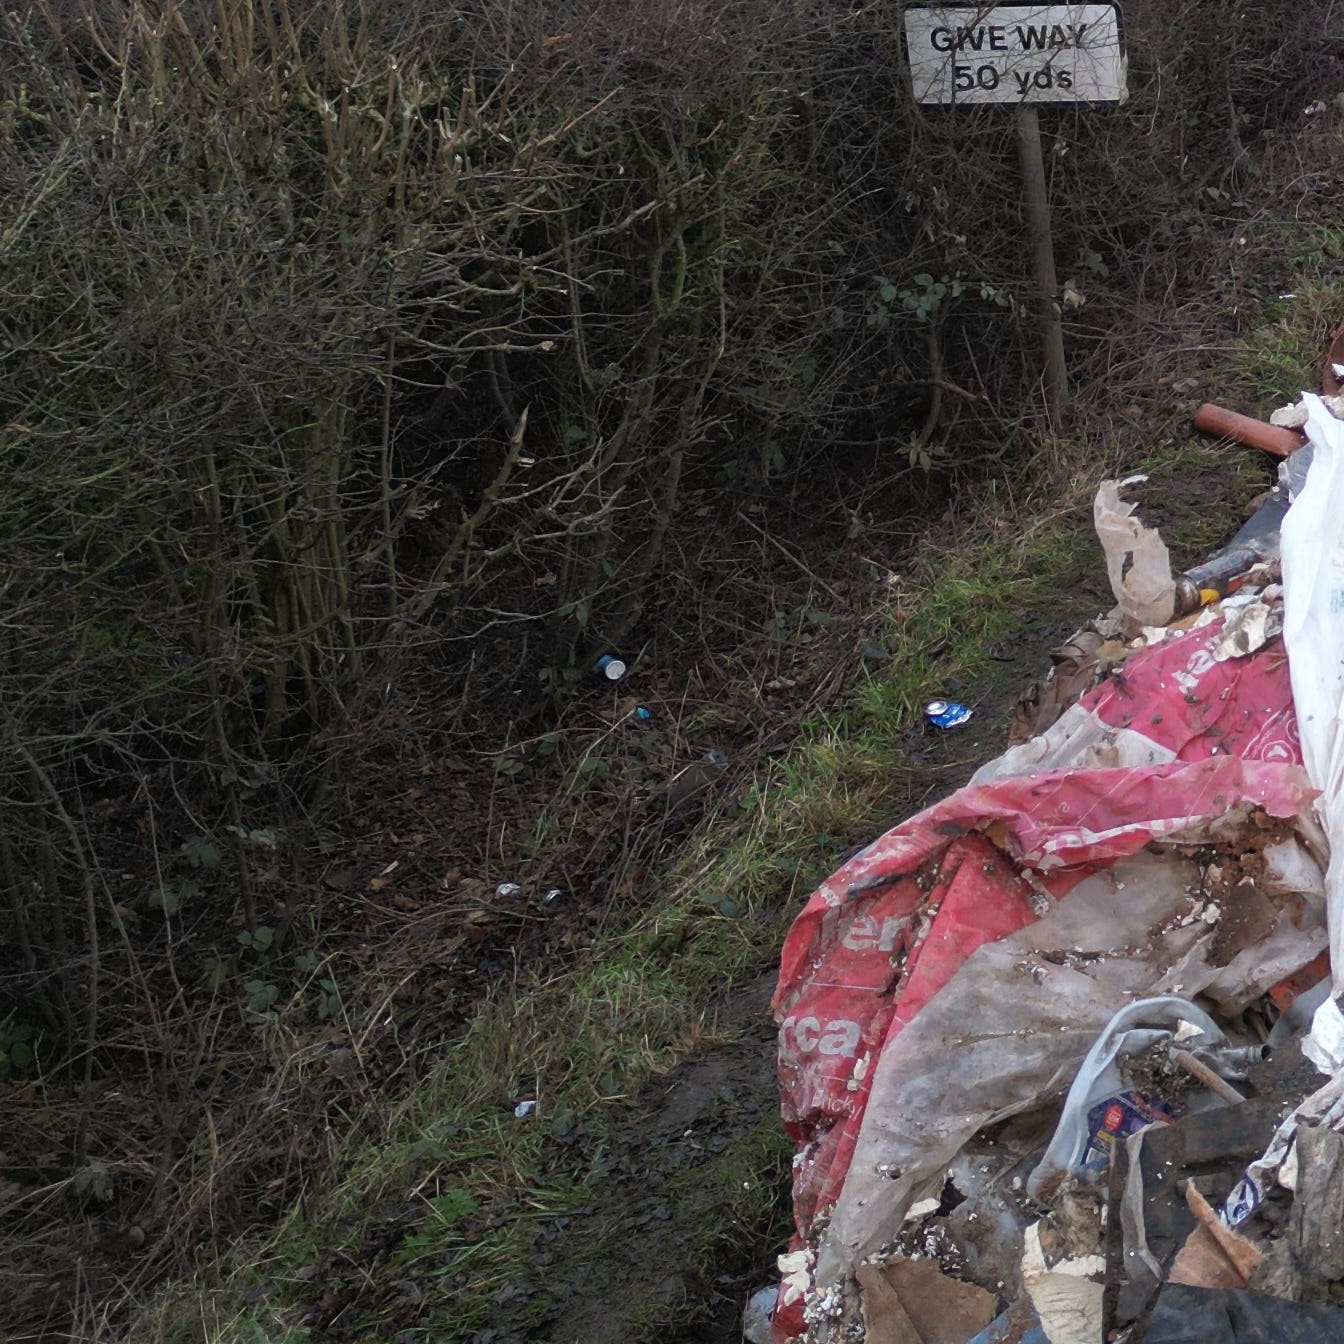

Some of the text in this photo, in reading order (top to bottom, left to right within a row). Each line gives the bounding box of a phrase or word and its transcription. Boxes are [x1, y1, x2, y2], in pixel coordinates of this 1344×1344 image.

[930, 24, 1089, 52] GIVE WAY
[955, 62, 1073, 95] 50 yds
